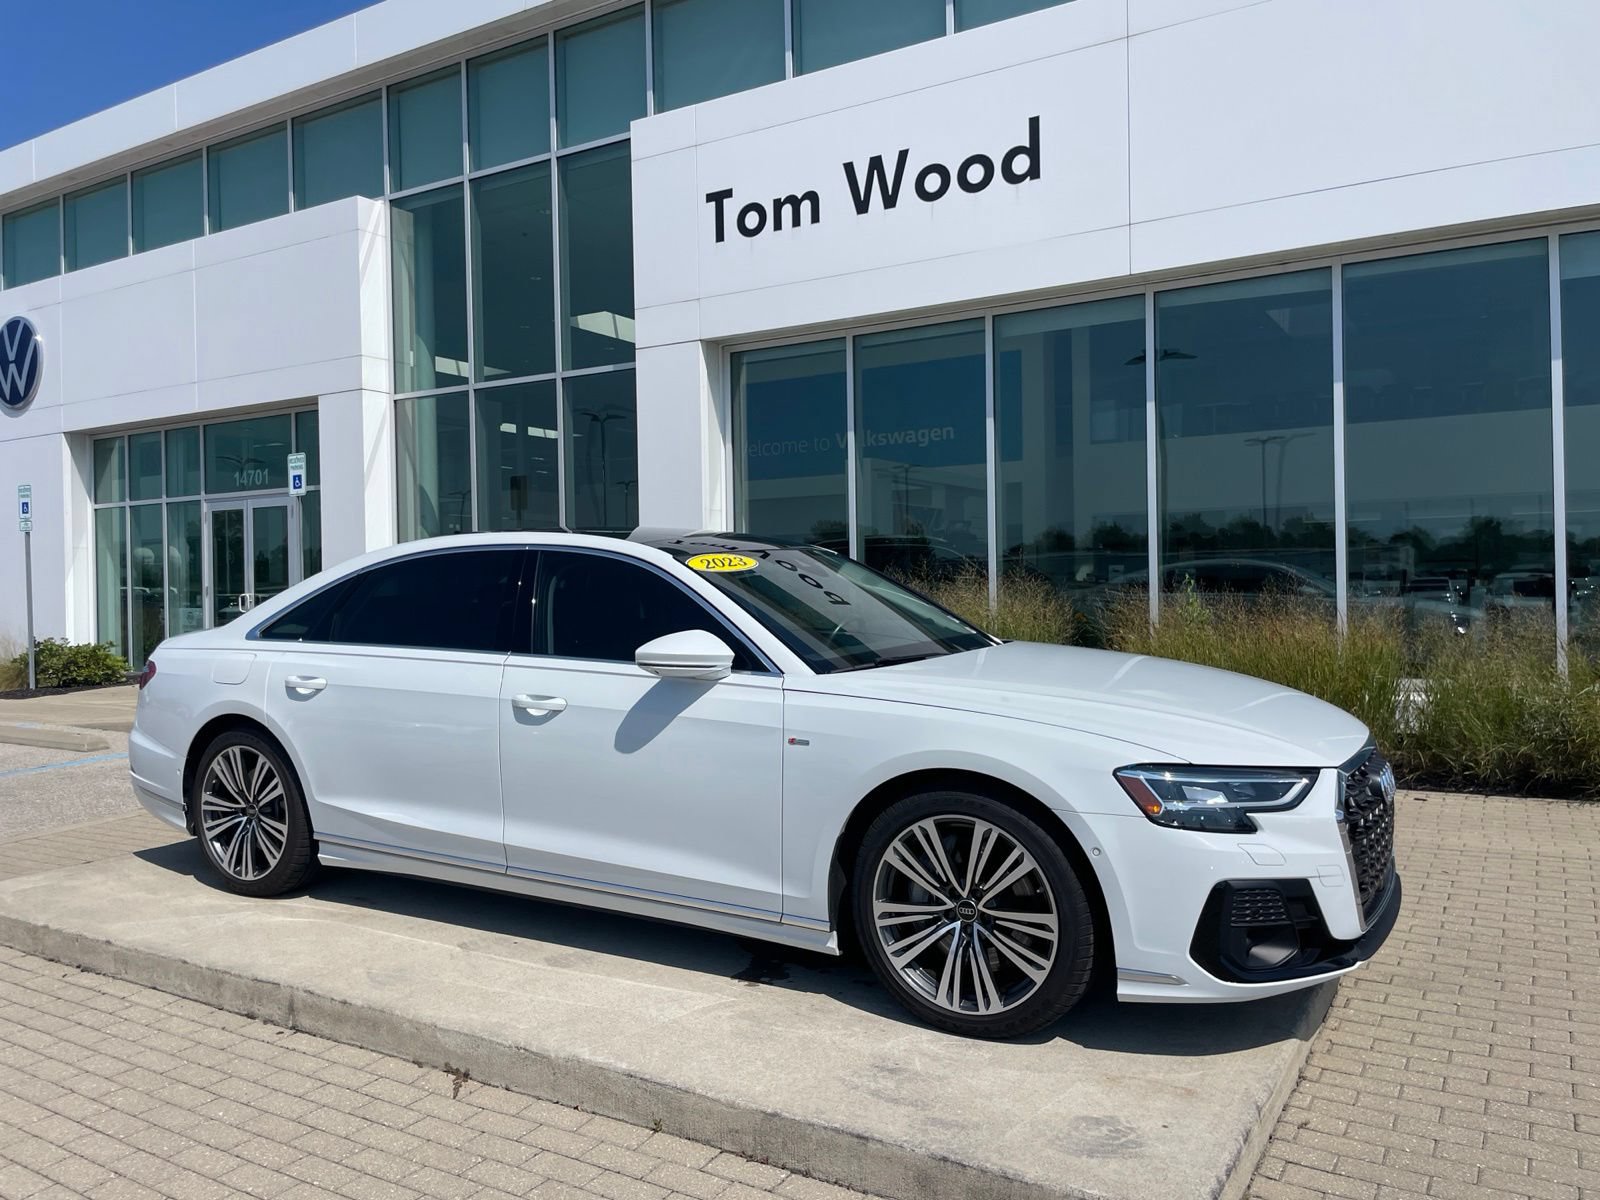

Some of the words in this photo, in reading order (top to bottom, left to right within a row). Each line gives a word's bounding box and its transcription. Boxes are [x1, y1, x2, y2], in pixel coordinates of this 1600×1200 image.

[705, 187, 821, 244] Tom
[842, 115, 1042, 216] Wood
[835, 426, 956, 449] Vlkswagen
[233, 468, 269, 487] 14701
[699, 556, 748, 570] 2023
